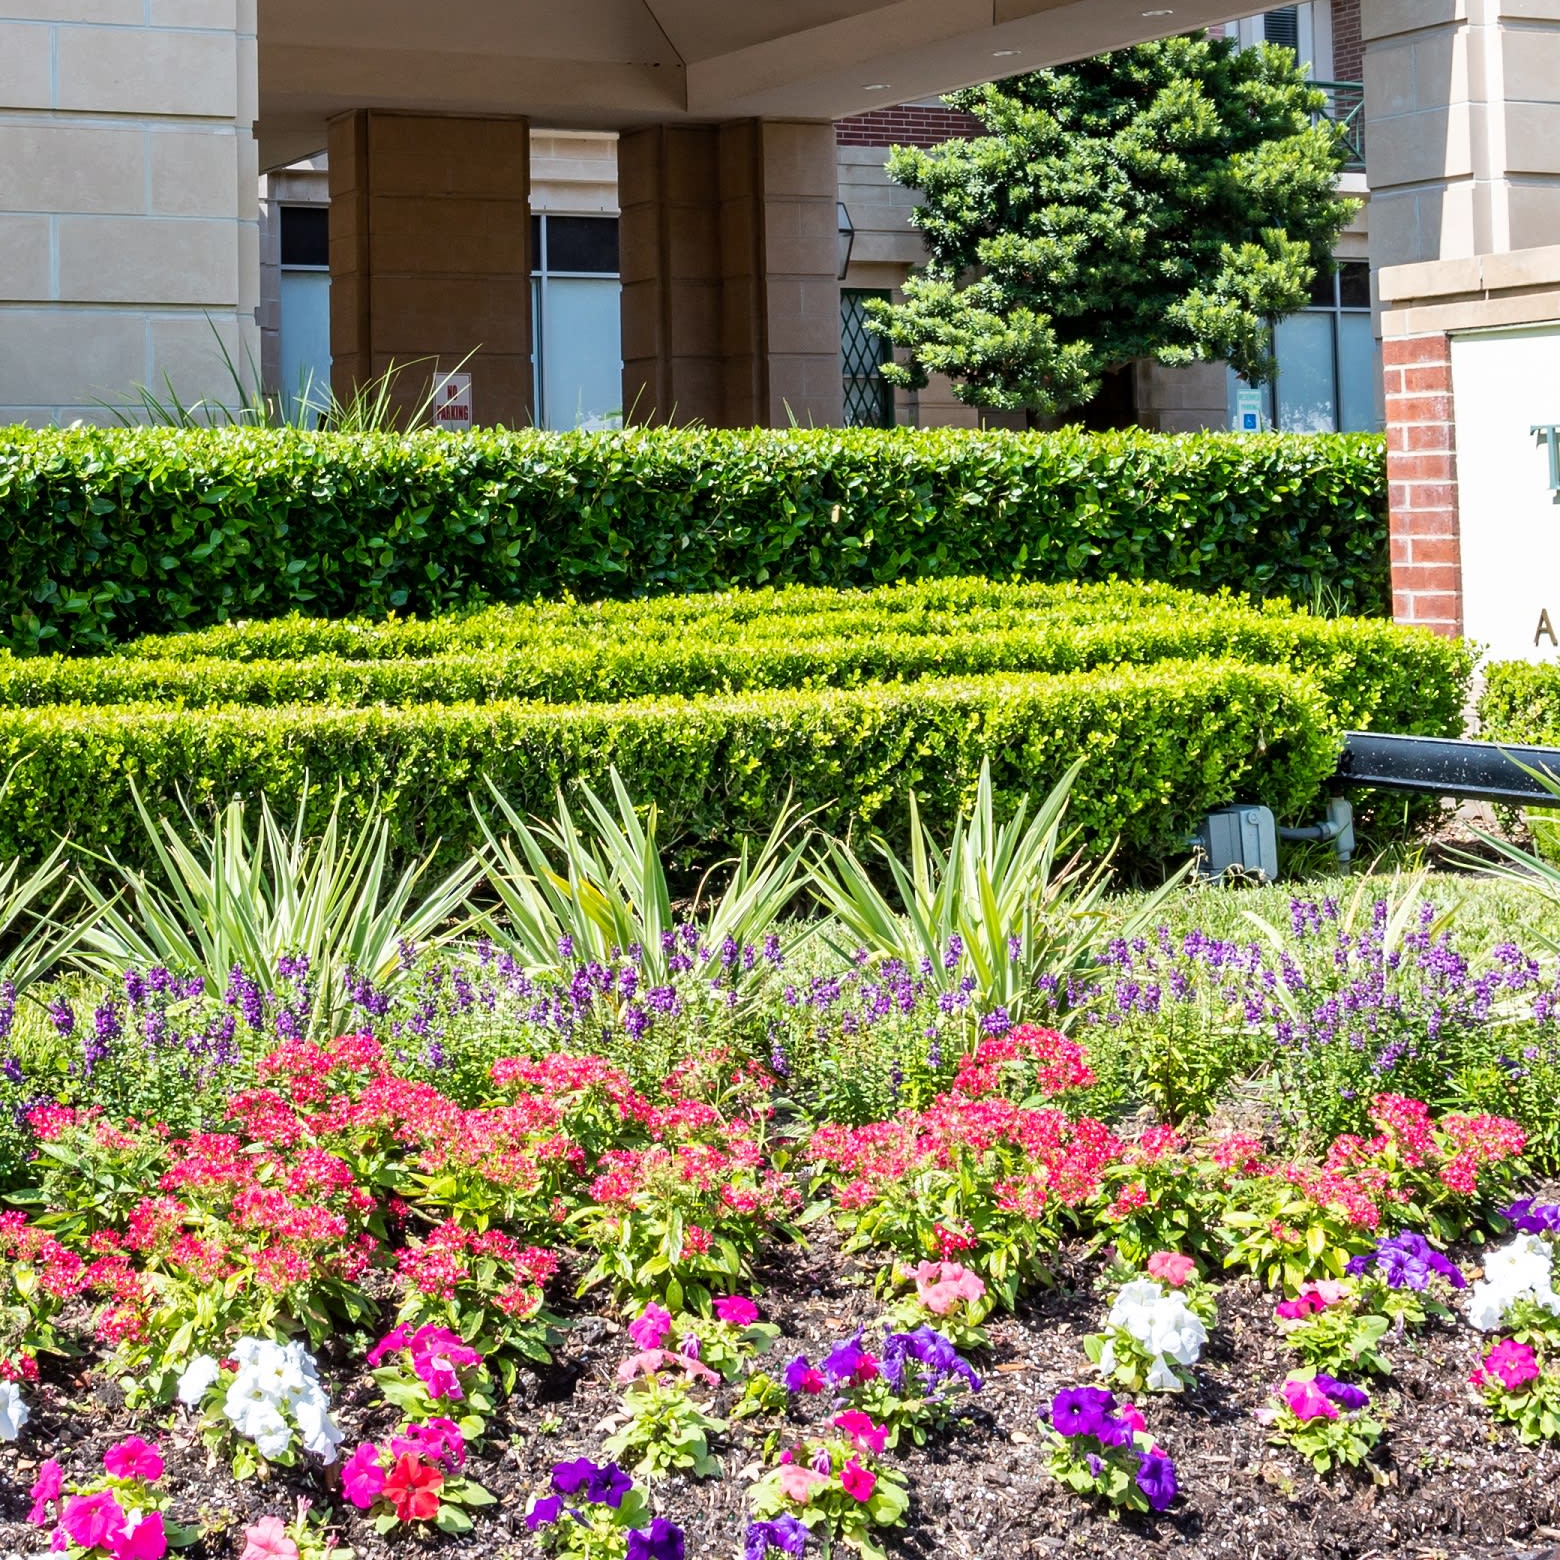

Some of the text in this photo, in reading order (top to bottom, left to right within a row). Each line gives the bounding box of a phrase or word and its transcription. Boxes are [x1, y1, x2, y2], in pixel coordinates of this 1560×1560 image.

[447, 384, 458, 401] NO
[436, 405, 469, 421] PARKING
[1534, 608, 1558, 647] A
